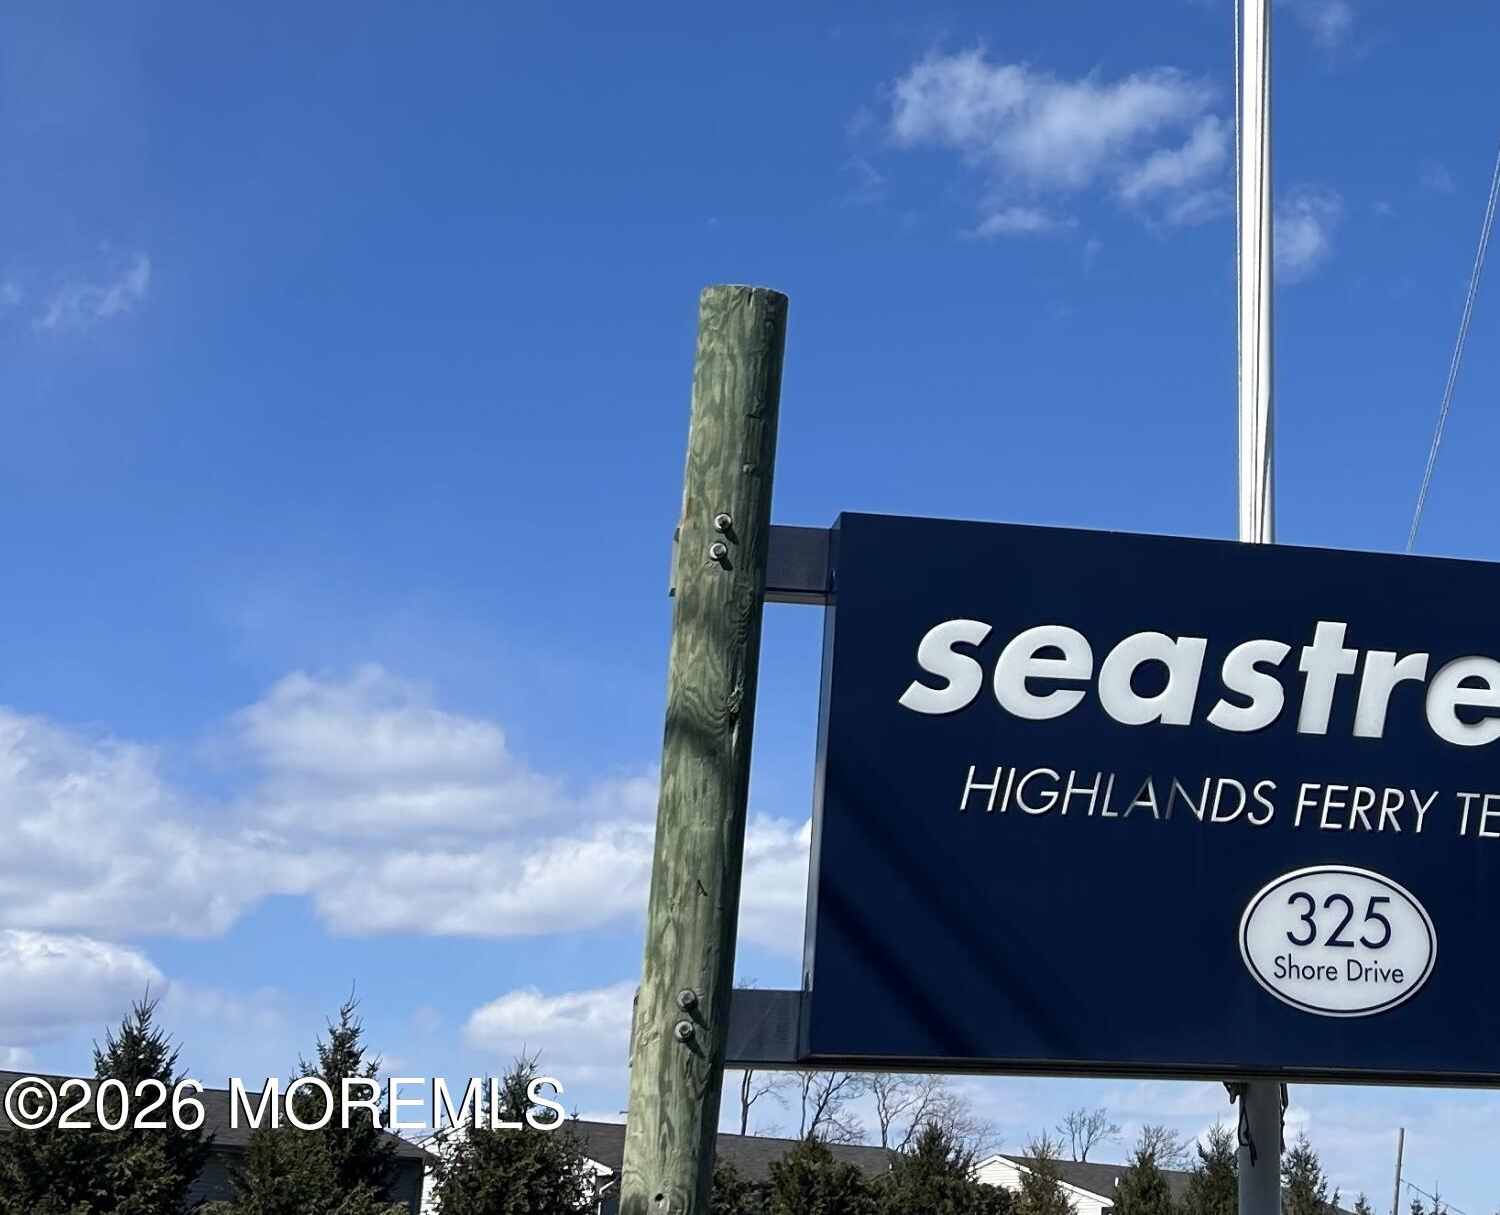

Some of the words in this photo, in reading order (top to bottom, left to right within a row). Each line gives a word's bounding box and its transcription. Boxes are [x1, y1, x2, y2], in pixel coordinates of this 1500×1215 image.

[959, 765, 1277, 827] HIGHLANDS
[1294, 783, 1439, 836] FERRY
[1286, 892, 1392, 949] 325
[1273, 954, 1338, 981] Shore
[1346, 958, 1404, 984] Drive
